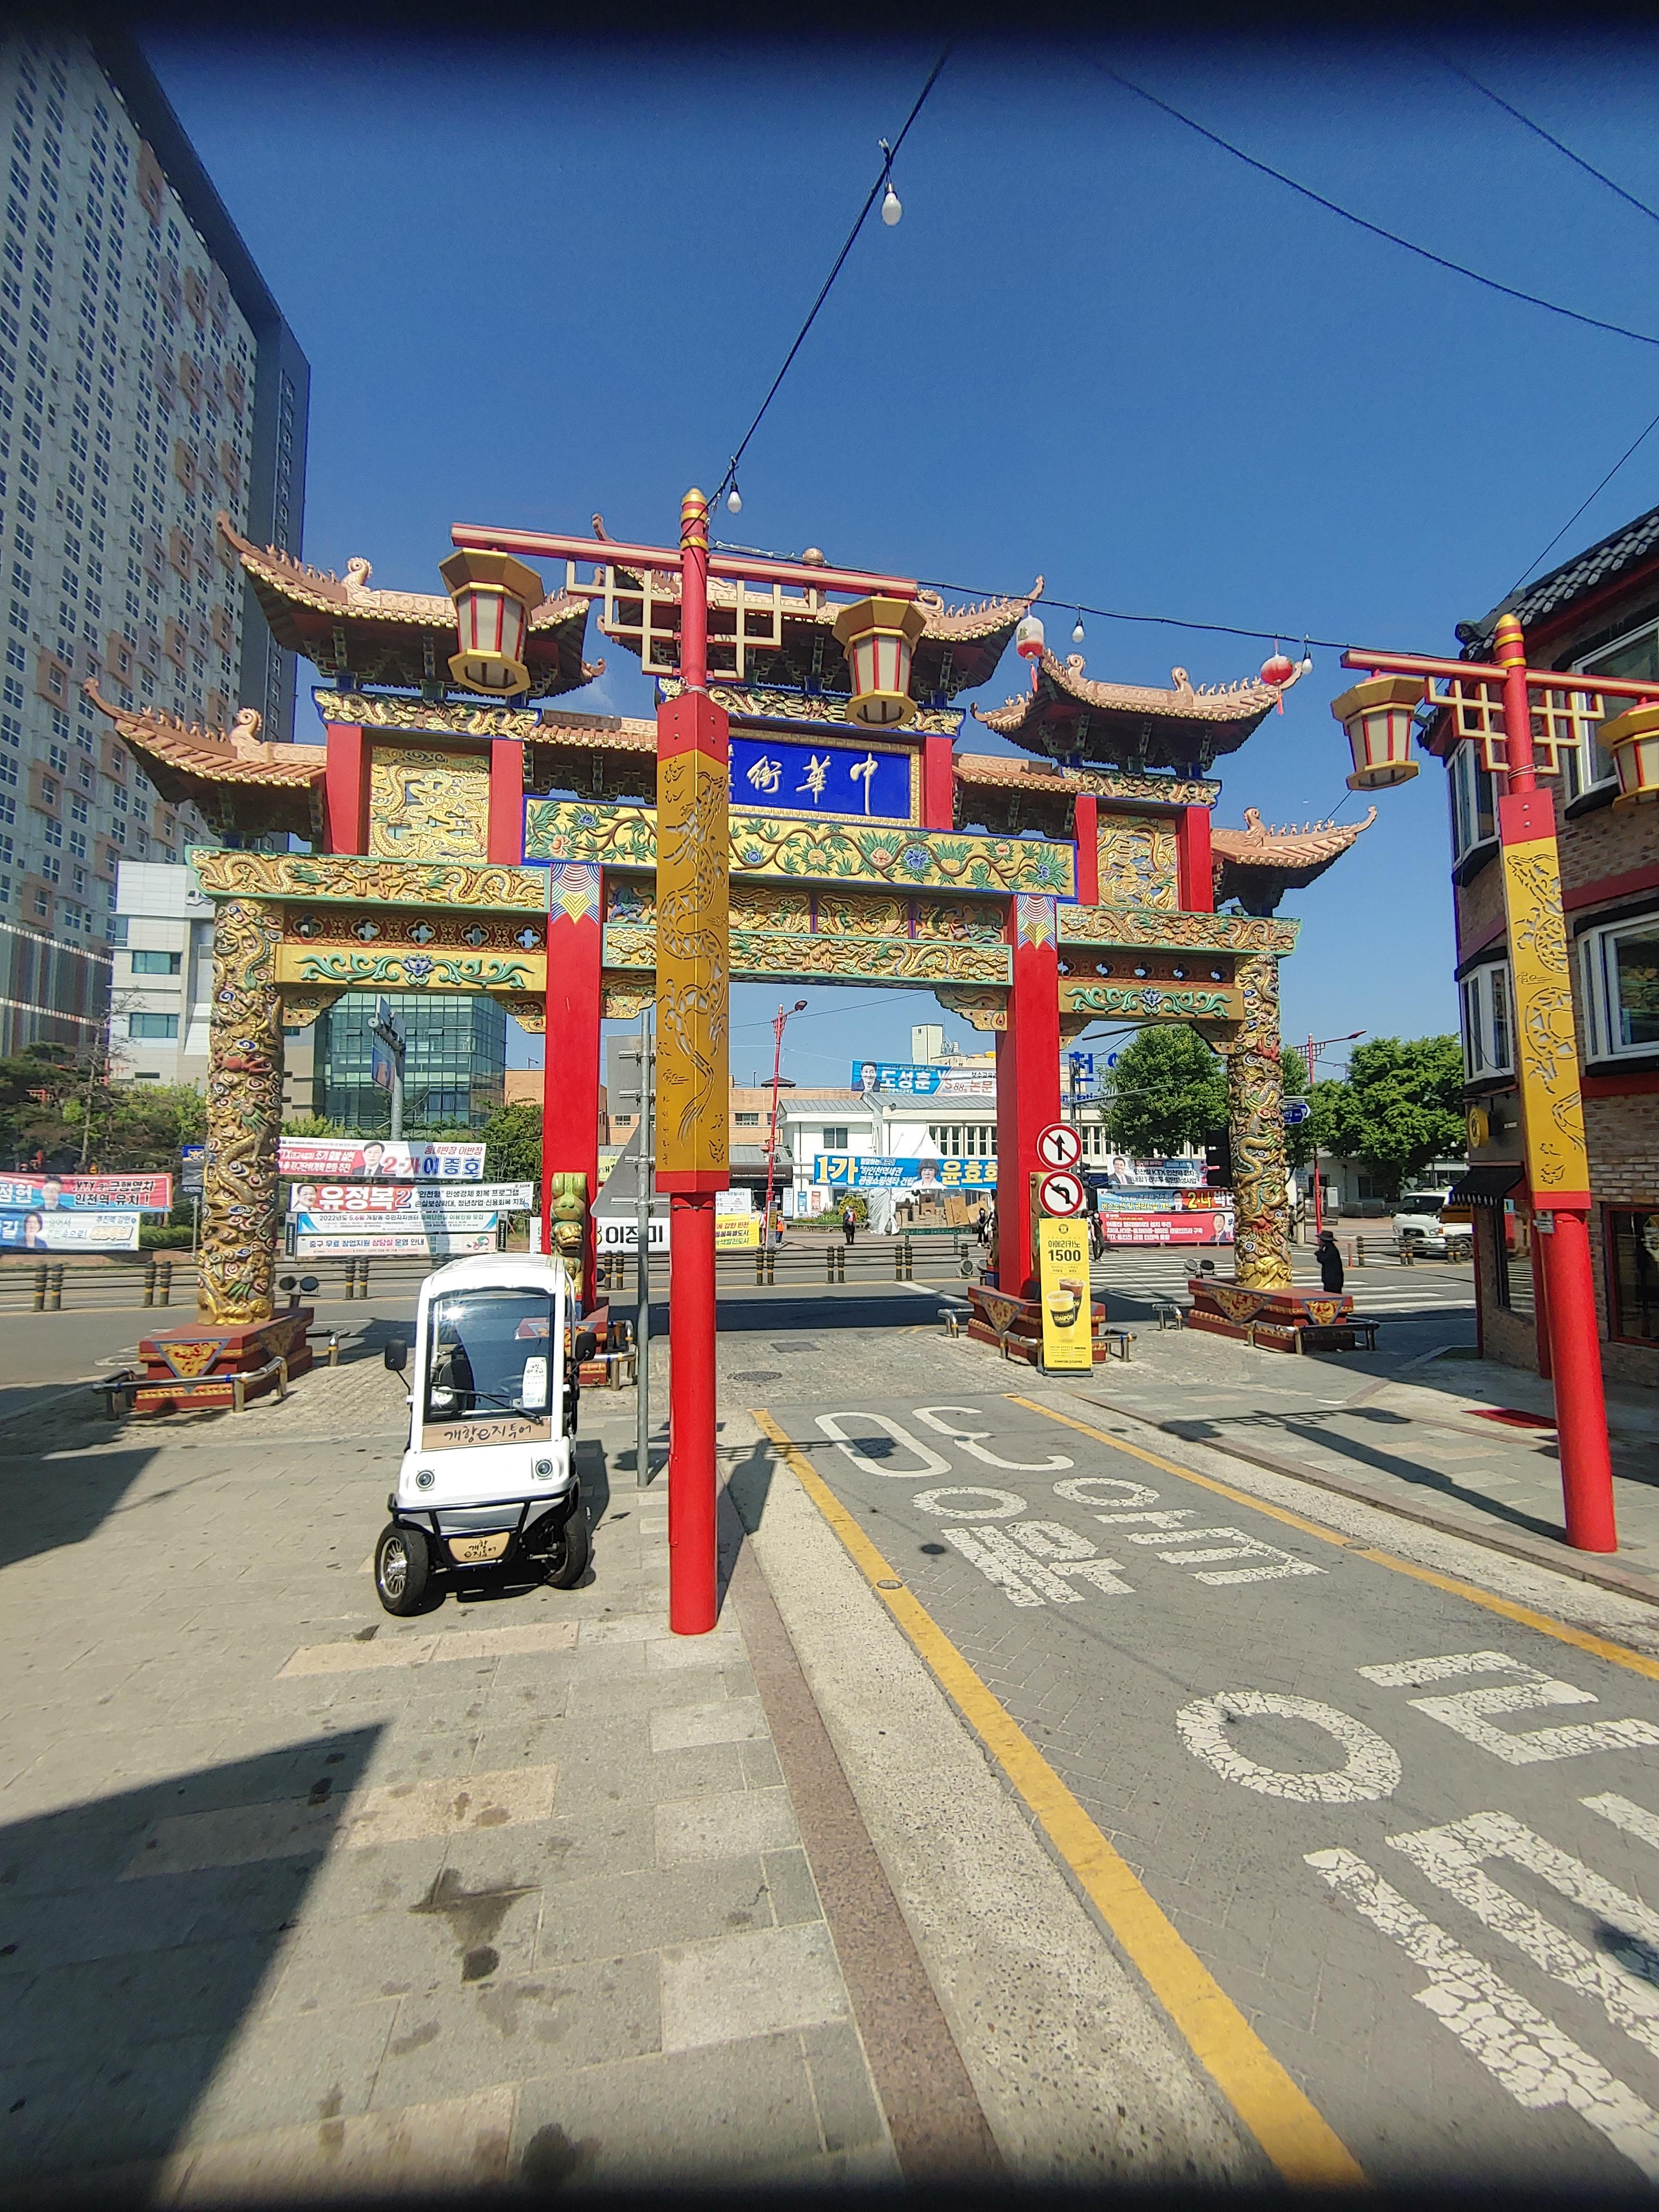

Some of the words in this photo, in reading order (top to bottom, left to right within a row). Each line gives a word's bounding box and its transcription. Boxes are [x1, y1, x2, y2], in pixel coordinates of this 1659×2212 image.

[880, 1069, 932, 1090] 도성훈
[424, 1146, 457, 1155] 동네반장
[458, 1146, 483, 1155] 이반장
[422, 1156, 482, 1176] 이종호
[817, 1156, 859, 1184] 1-가
[107, 1180, 155, 1192] 급행열차
[76, 1193, 110, 1205] 인천역
[320, 1186, 395, 1210] 유정복
[395, 1187, 413, 1209] 2
[0, 1220, 19, 1239] 길
[342, 1239, 371, 1247] 창업지원
[1048, 1250, 1081, 1262] 1500
[468, 1539, 488, 1549] 개항
